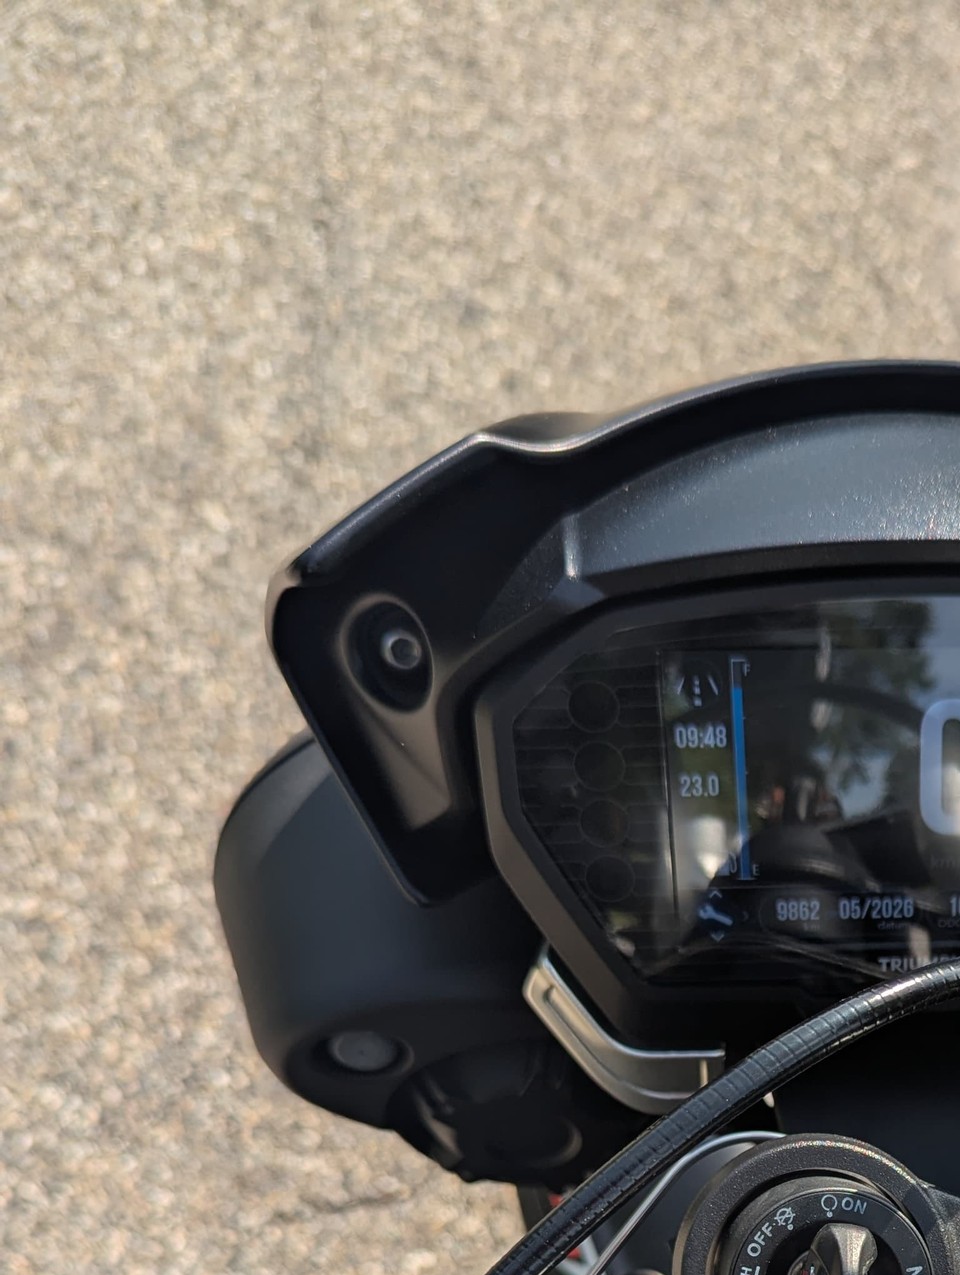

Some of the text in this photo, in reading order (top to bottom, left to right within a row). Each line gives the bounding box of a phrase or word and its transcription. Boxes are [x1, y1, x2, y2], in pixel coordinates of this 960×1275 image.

[674, 725, 727, 749] 09:48
[679, 774, 720, 798] 23.0
[776, 899, 821, 921] 9862
[838, 896, 914, 920] 05/2026
[841, 1198, 867, 1215] ON
[747, 1222, 774, 1257] OFF
